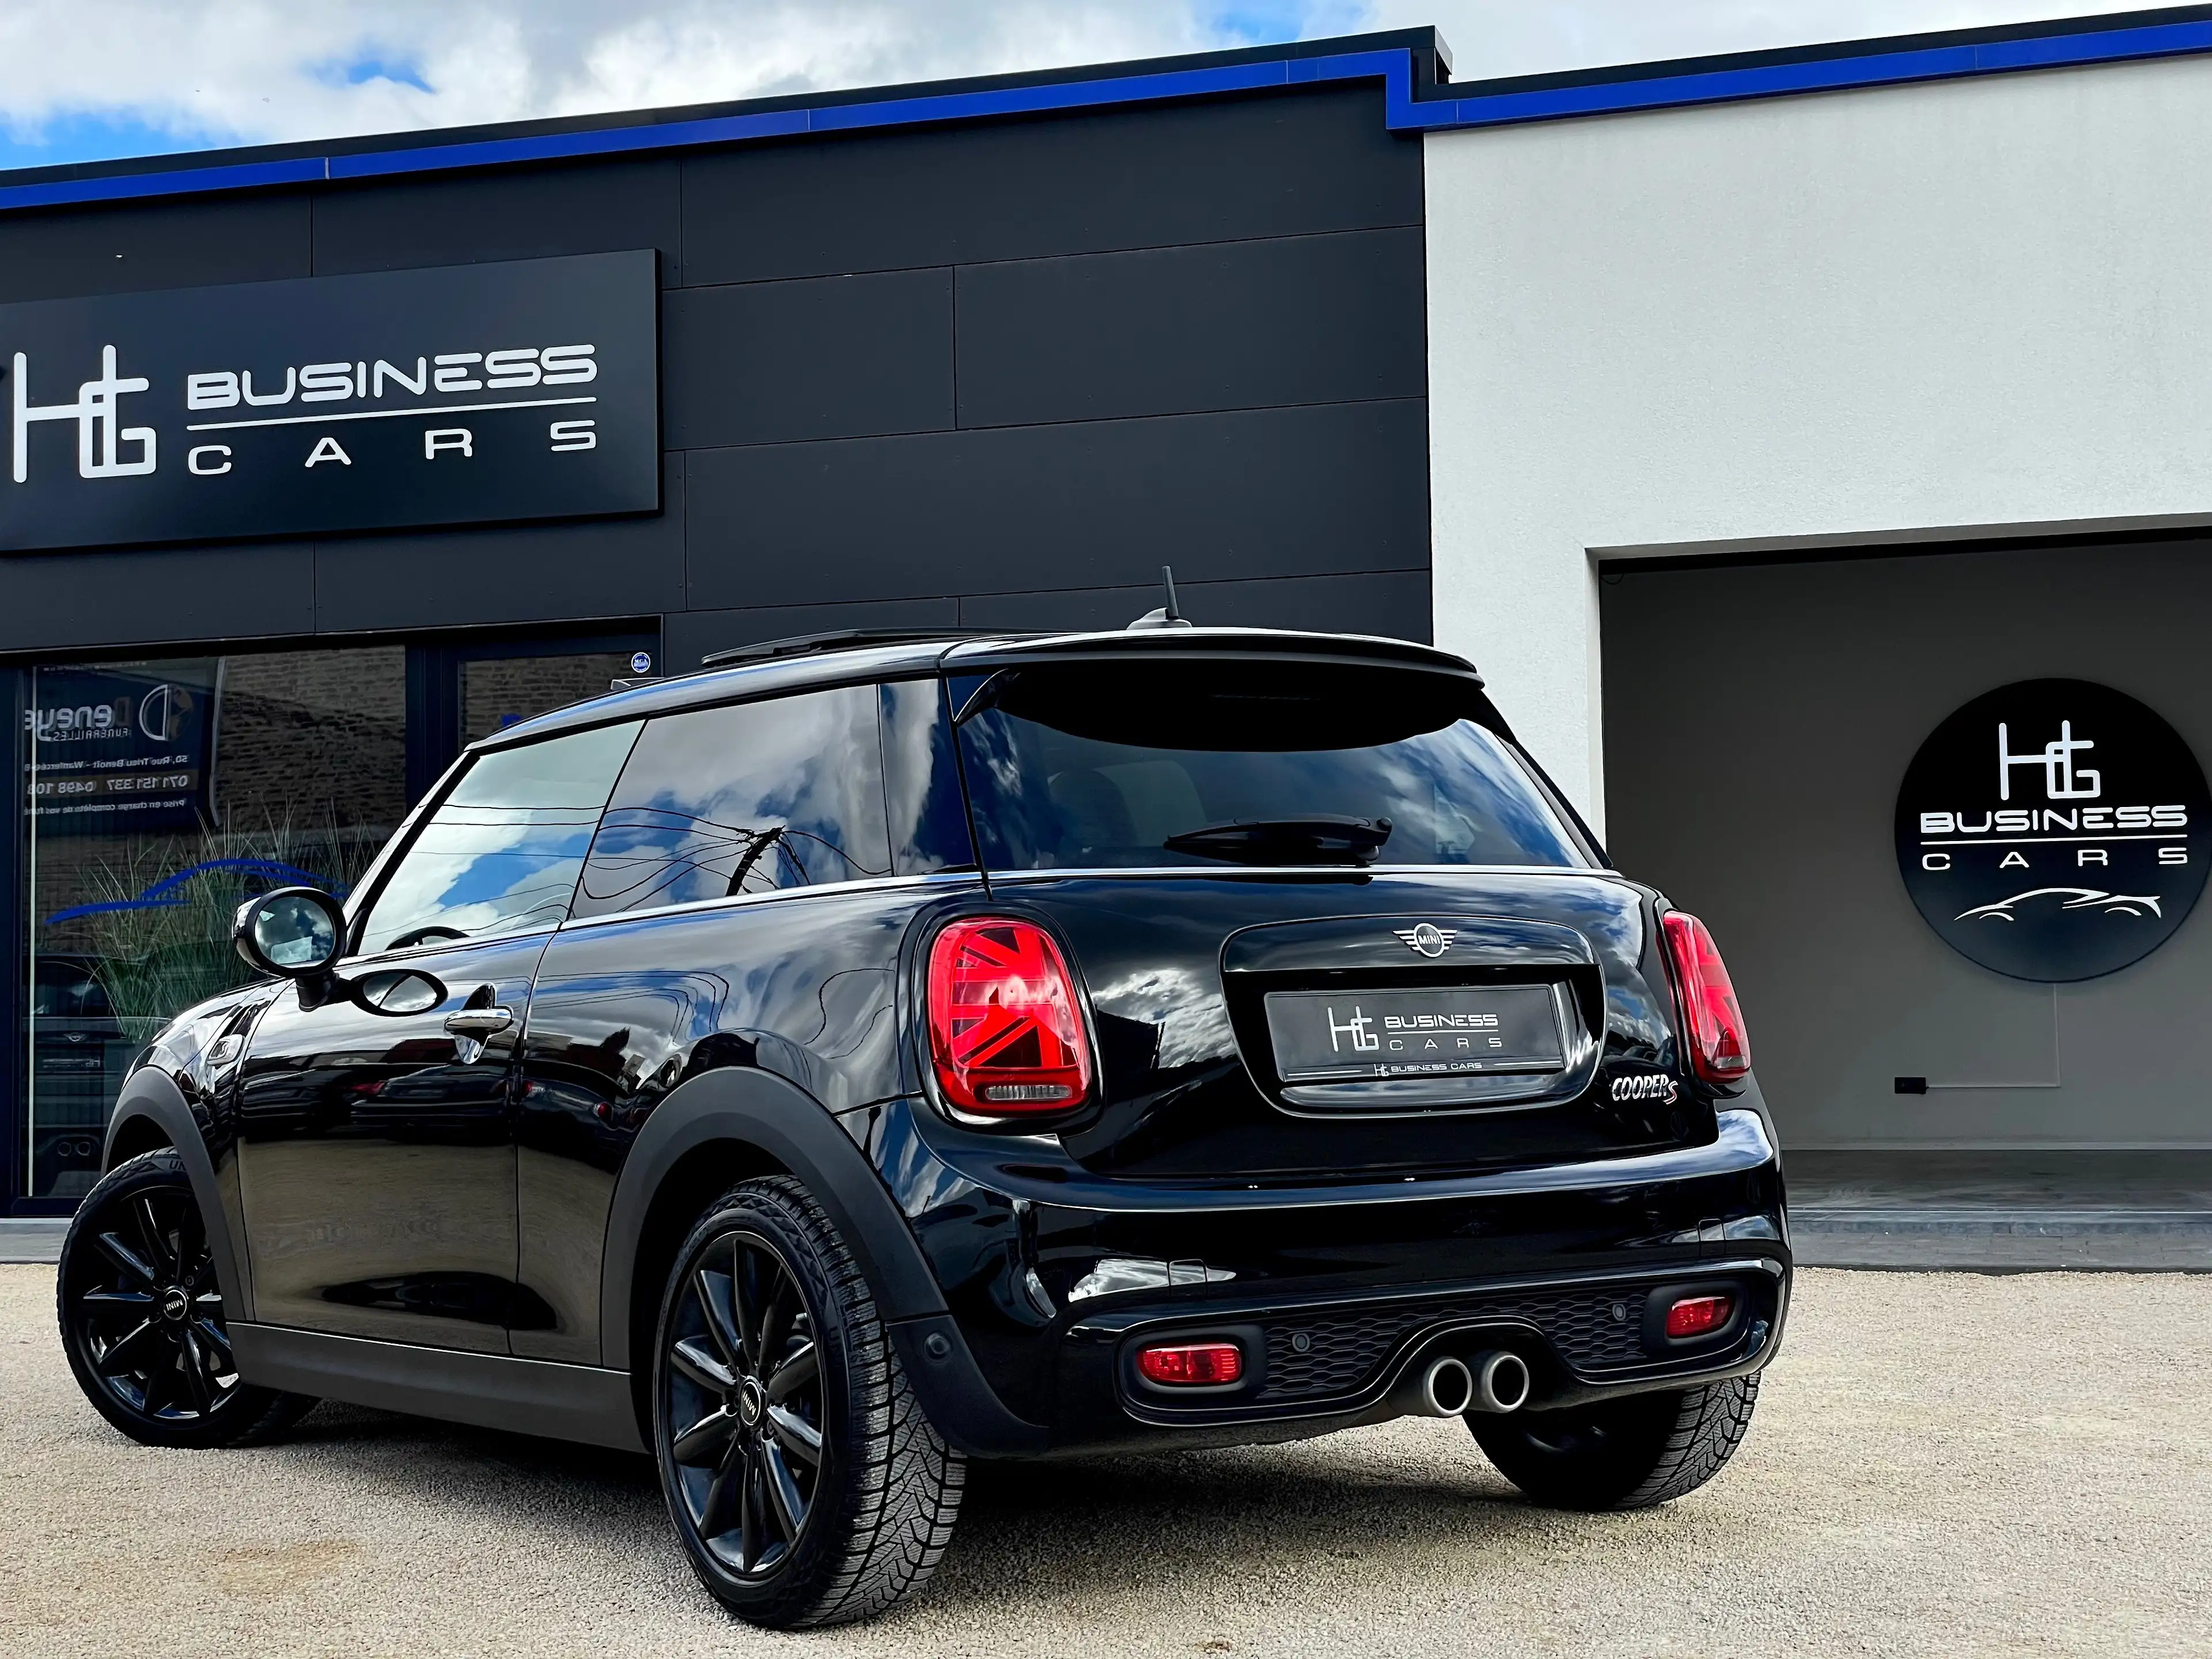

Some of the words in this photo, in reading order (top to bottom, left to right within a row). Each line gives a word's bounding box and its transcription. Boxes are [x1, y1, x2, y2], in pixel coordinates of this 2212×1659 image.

[187, 344, 597, 410] BUSINESS
[188, 421, 596, 475] CARS
[1921, 805, 2187, 833] BUSINESS
[1922, 847, 2187, 870] CARS
[1418, 935, 1441, 944] MINI
[1384, 1014, 1498, 1028] BUSINESS
[1389, 1037, 1502, 1050] CARS
[1391, 1063, 1448, 1072] BUSINESS
[1612, 1074, 1669, 1101] COOPER
[166, 1300, 183, 1311] MINI
[742, 1390, 756, 1416] MINI
